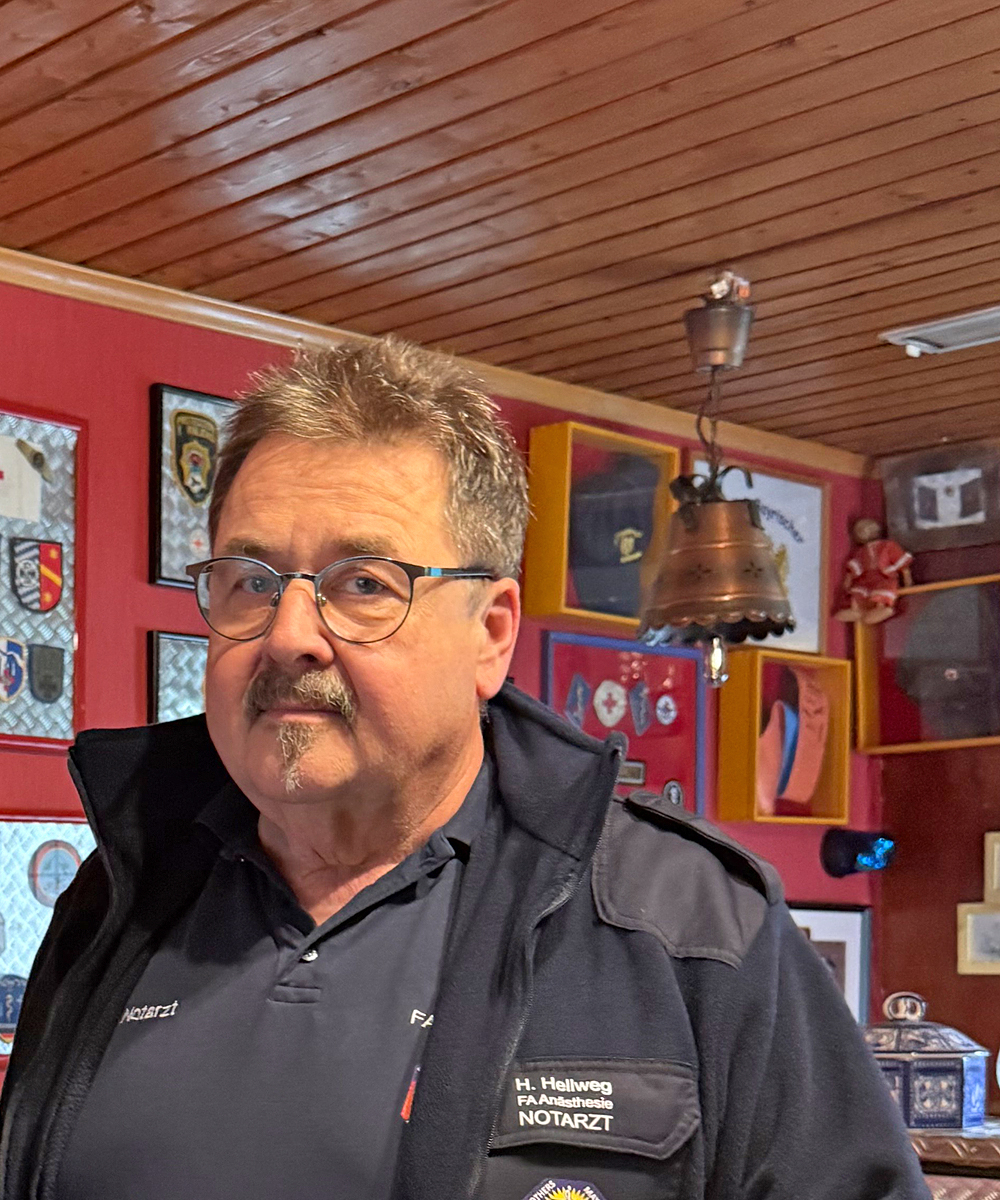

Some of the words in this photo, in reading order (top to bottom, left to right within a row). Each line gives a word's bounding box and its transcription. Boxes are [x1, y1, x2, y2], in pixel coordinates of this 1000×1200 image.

[515, 1078, 537, 1091] H.
[540, 1076, 614, 1096] Hellweg
[517, 1095, 538, 1107] FA
[519, 1109, 615, 1132] NOTARZT
